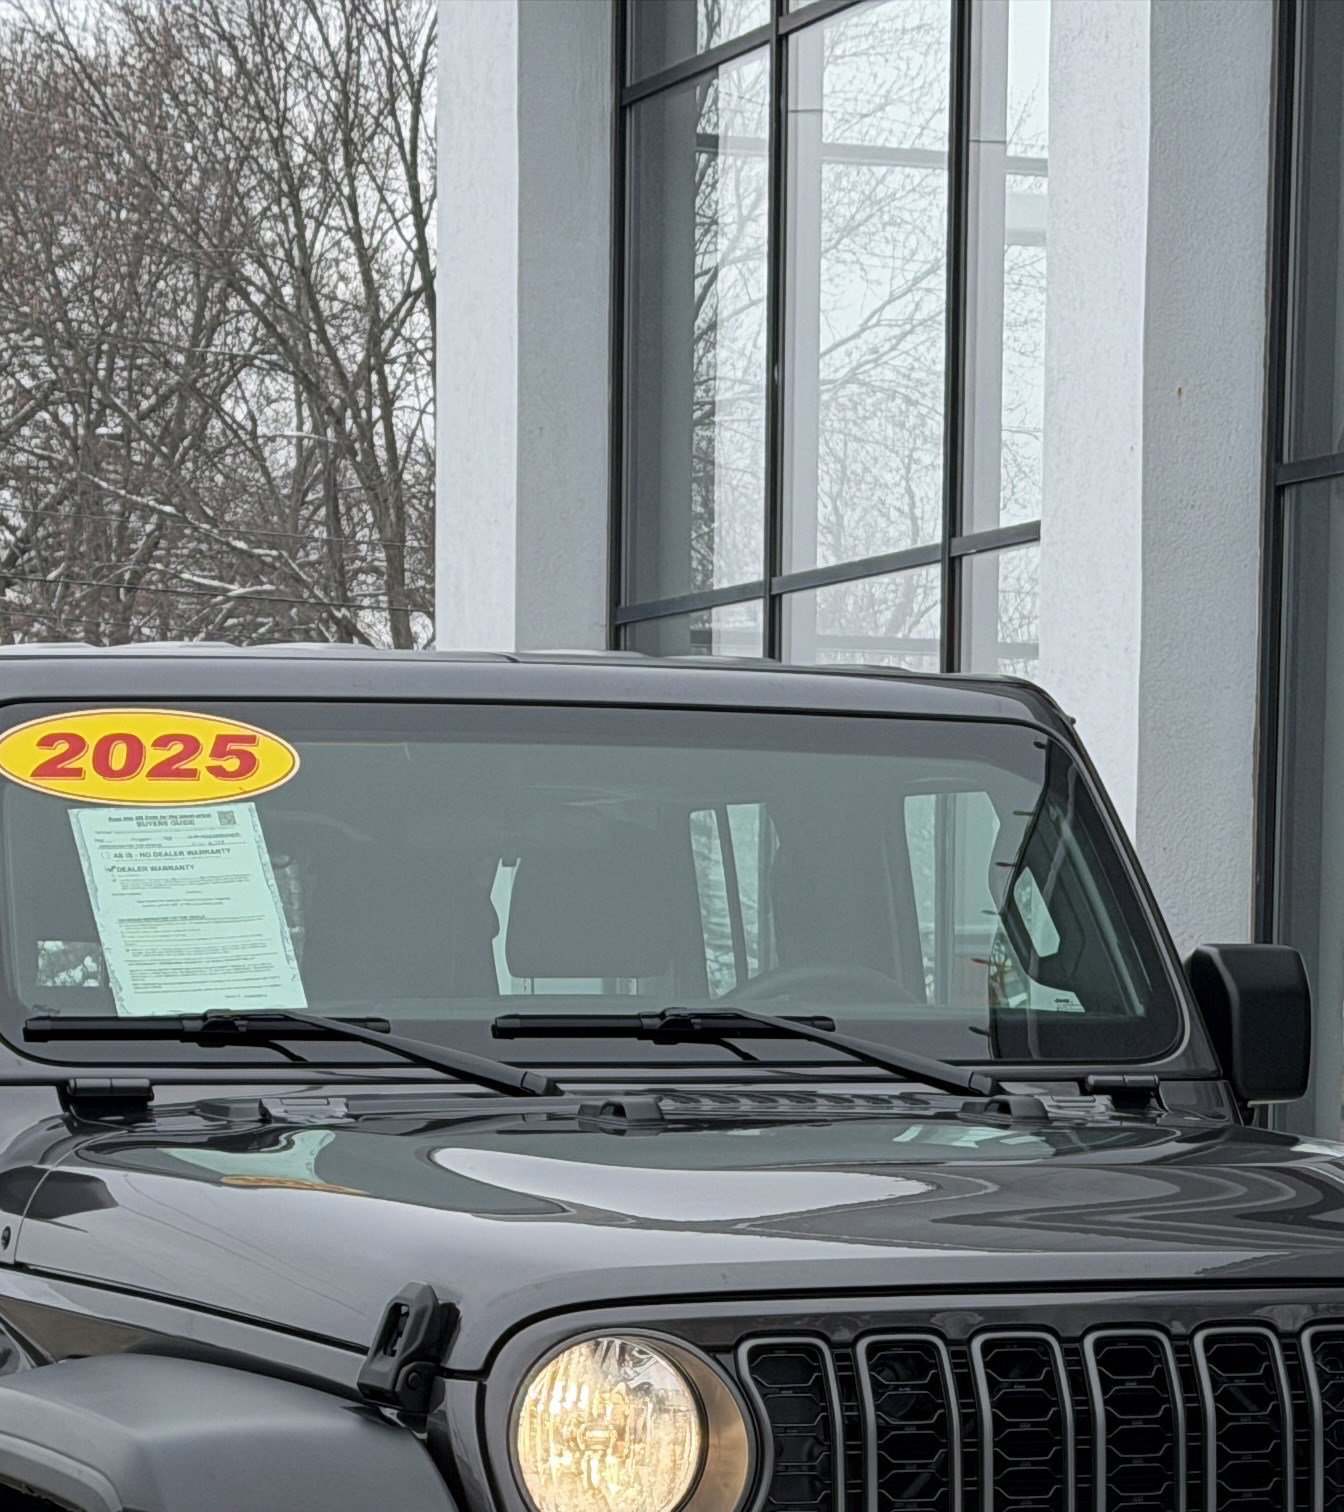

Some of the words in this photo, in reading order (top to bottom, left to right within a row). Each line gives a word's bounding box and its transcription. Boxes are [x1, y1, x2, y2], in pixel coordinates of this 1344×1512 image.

[31, 732, 259, 782] 2025
[153, 850, 185, 858] DEALER
[186, 847, 231, 857] WARRANTY
[116, 865, 149, 873] DEALER
[150, 864, 195, 872] WARRANTY
